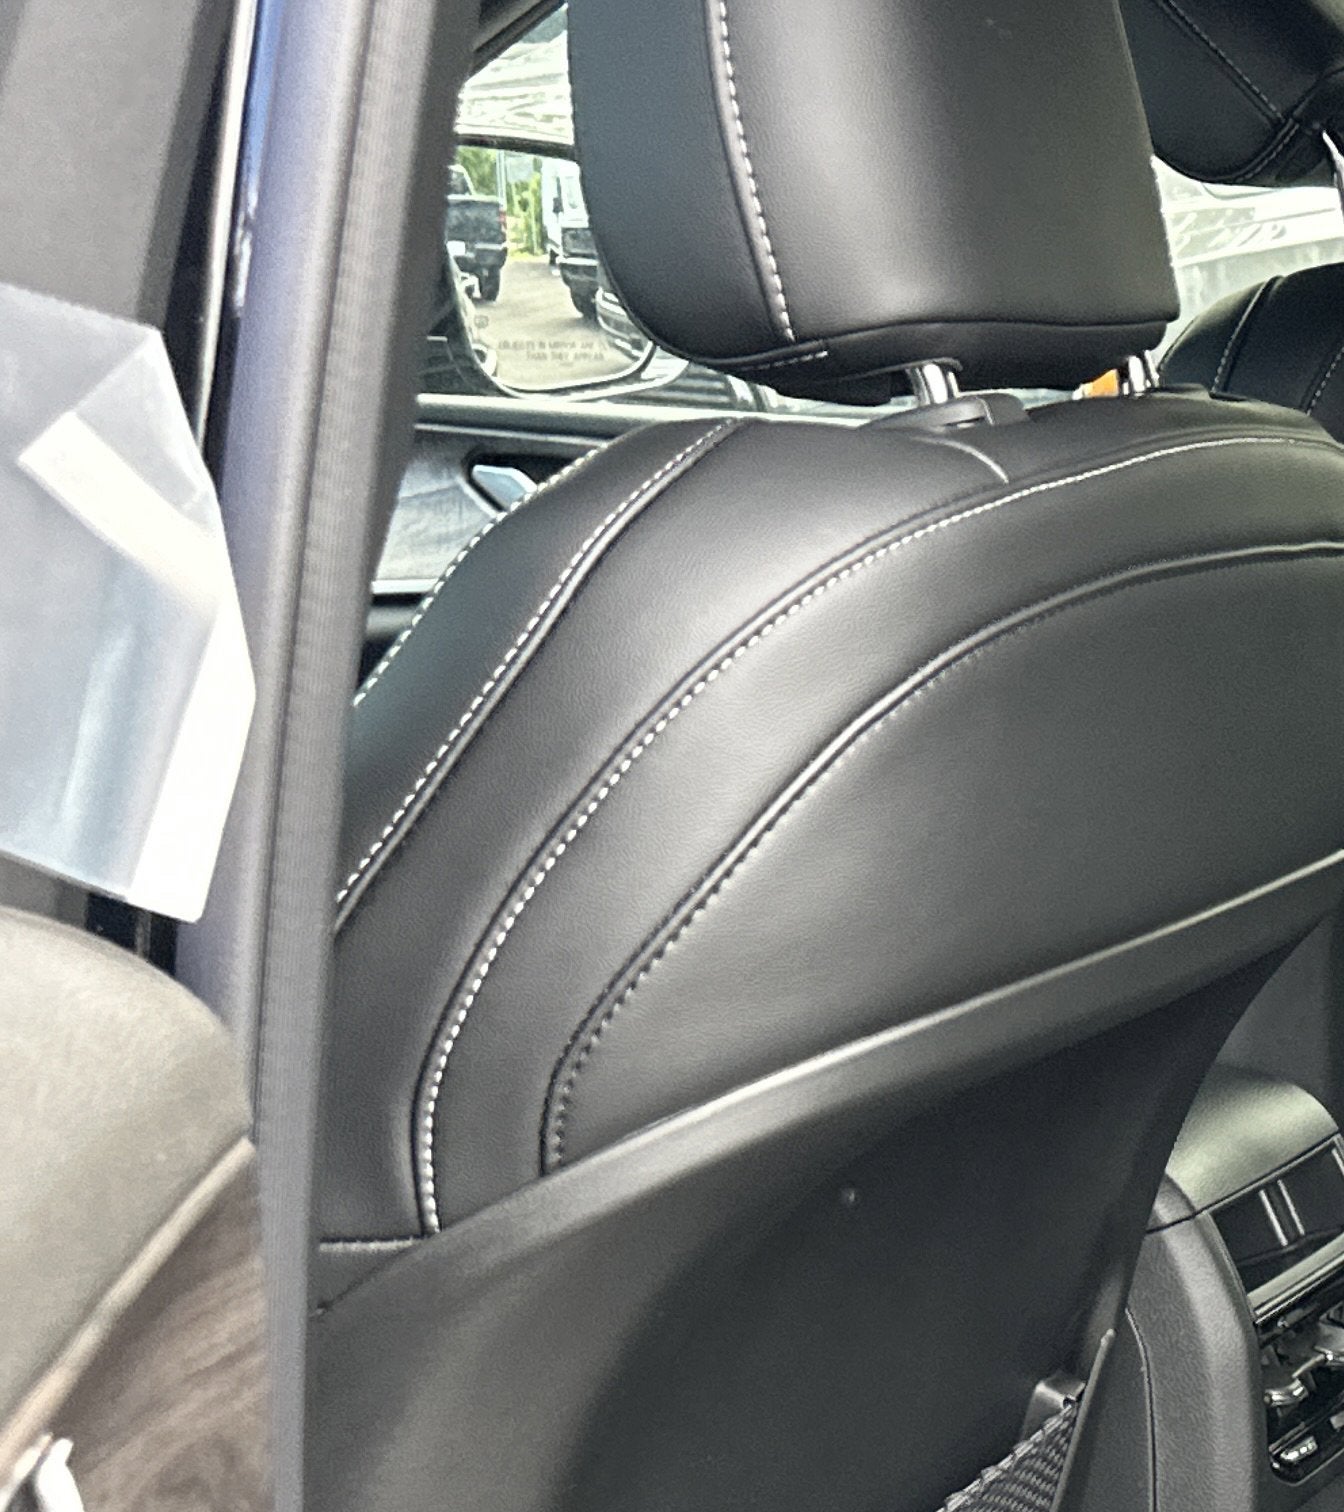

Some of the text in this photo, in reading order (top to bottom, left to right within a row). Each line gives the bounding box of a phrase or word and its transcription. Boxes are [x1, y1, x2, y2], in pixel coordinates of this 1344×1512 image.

[526, 352, 604, 361] THAN THEY APPEAR
